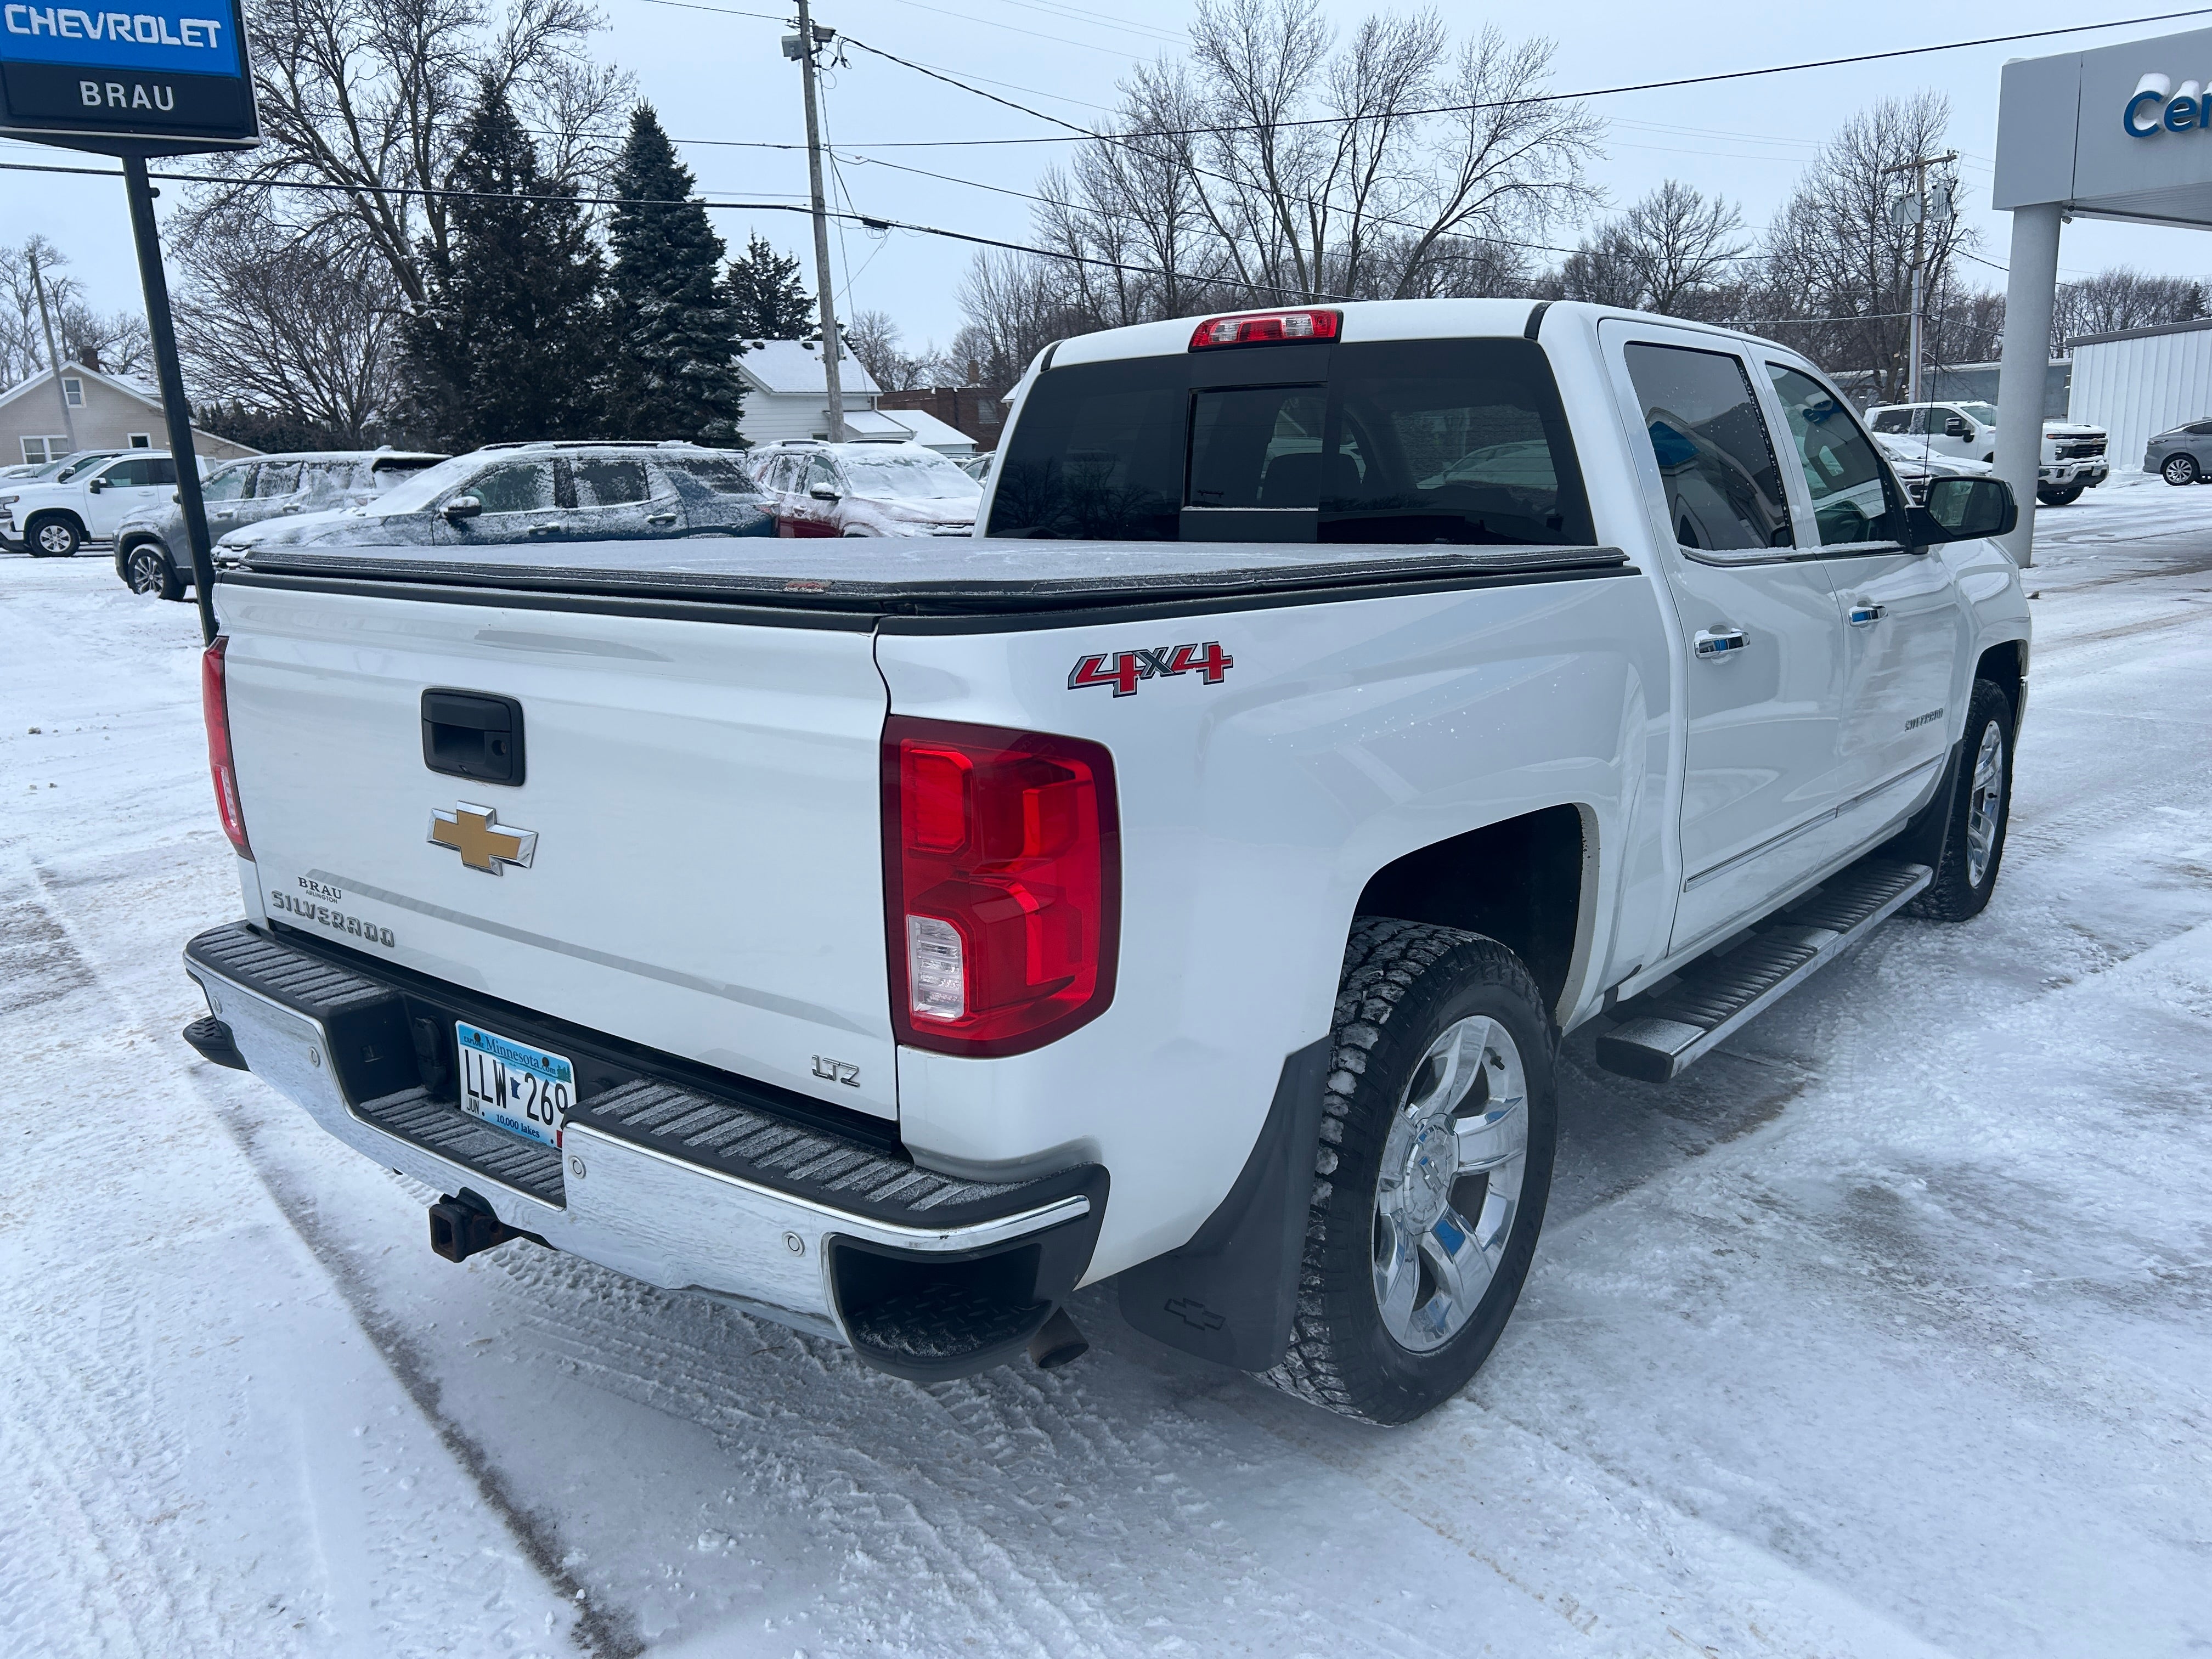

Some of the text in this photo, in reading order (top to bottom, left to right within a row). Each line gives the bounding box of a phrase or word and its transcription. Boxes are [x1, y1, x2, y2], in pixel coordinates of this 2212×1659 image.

[4, 4, 221, 49] CHEVROLET
[80, 80, 174, 111] BRAU
[297, 877, 342, 899] BRAU
[306, 889, 338, 904] ARLINGTON
[271, 890, 395, 947] SILVERADO
[465, 1049, 507, 1109] LLW
[812, 1054, 860, 1087] LTZ
[467, 1097, 479, 1114] JUN
[496, 1114, 540, 1138] 10,000 lakes
